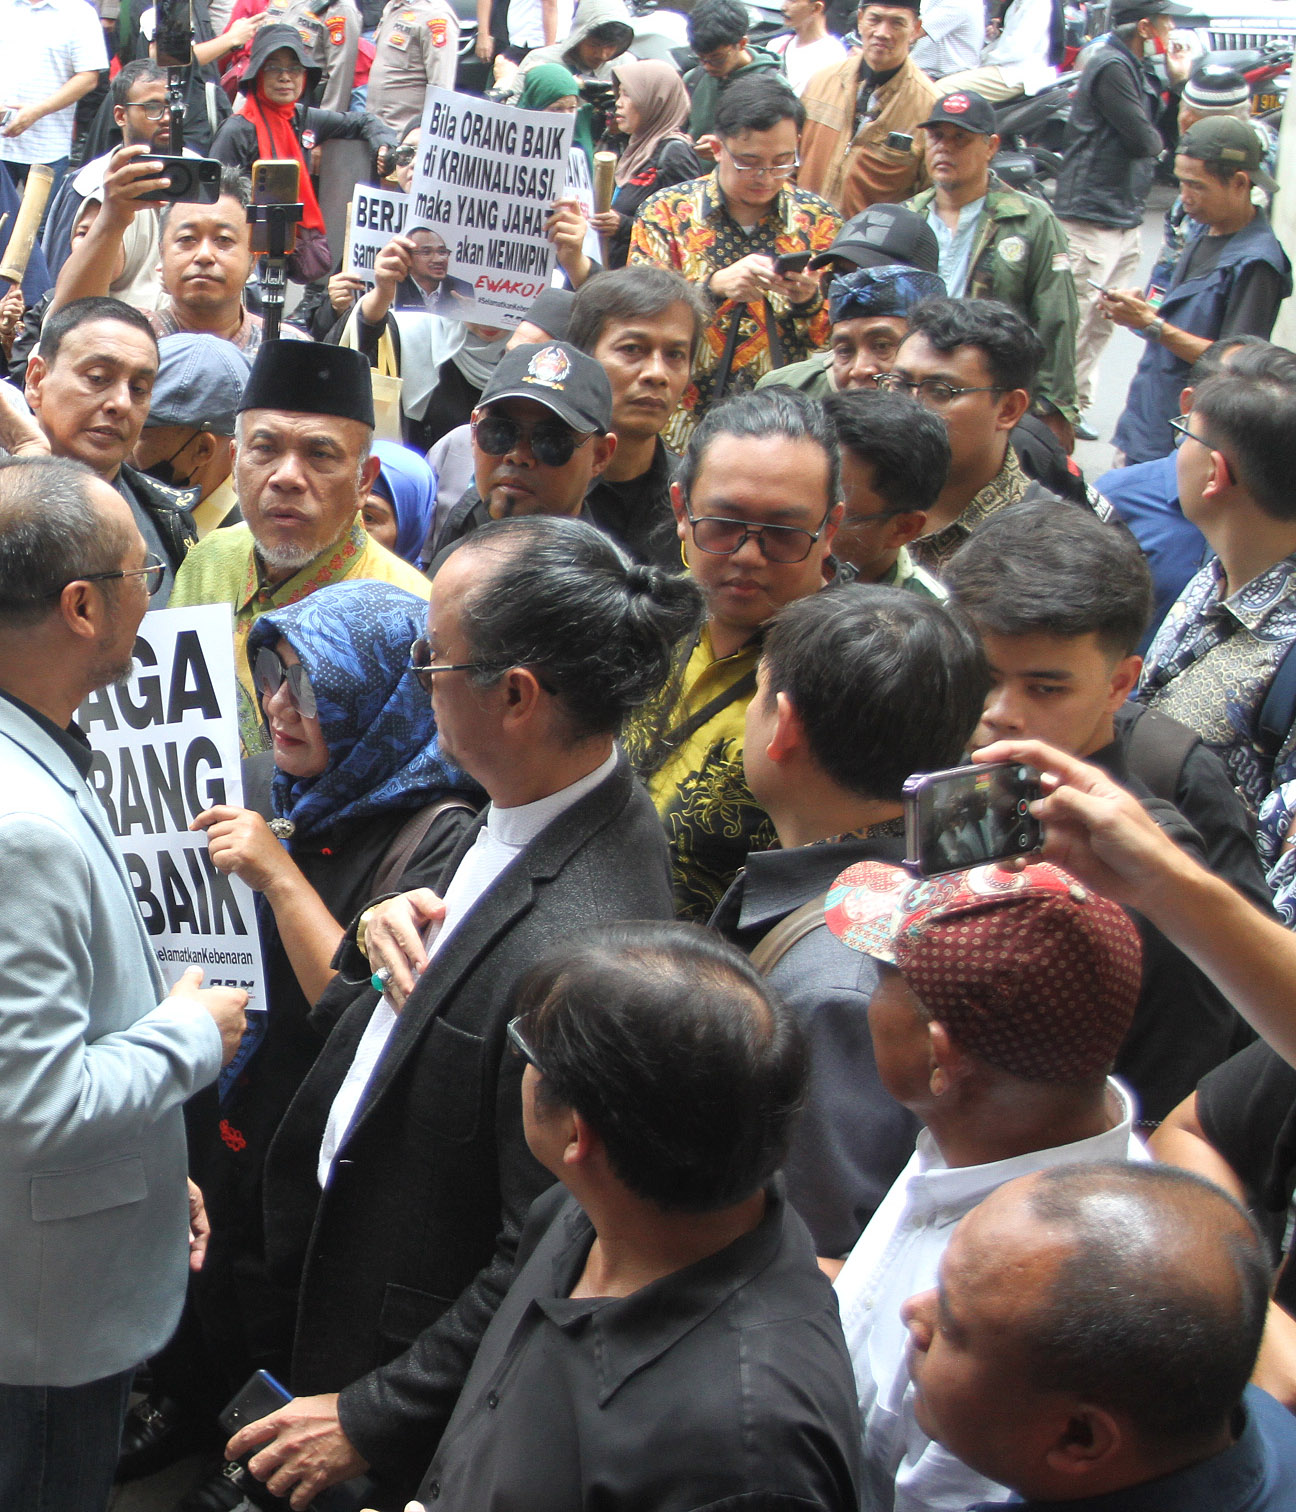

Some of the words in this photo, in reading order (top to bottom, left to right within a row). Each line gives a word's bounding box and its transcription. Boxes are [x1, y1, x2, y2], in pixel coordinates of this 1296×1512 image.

[429, 102, 457, 141] Bila
[460, 110, 517, 155] ORANG
[521, 125, 565, 160] BAIK
[422, 145, 438, 178] di
[415, 190, 452, 224] maka
[457, 195, 498, 231] YANG
[455, 235, 484, 266] akan
[486, 239, 549, 277] MEMIMPIN
[474, 275, 545, 299] EWAKO!
[122, 846, 249, 936] BAIK
[156, 946, 254, 965] elamatkanKebenaran
